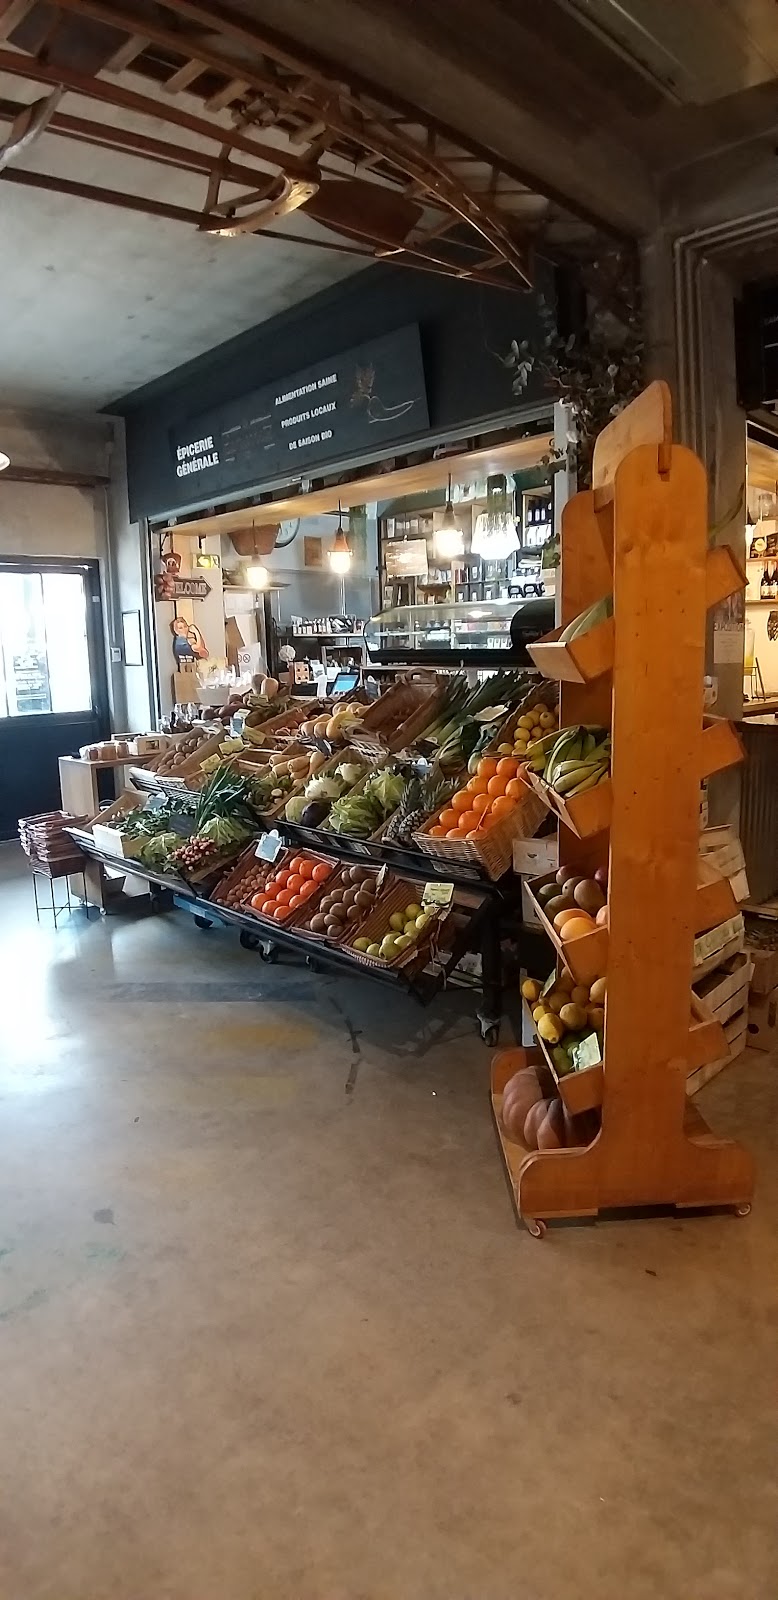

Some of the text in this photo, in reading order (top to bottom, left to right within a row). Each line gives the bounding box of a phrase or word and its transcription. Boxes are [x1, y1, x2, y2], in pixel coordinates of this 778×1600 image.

[275, 373, 338, 406] ALIMENTATION SAINE
[281, 401, 337, 429] PRODUITS LOCAUX
[176, 436, 214, 461] ÉPICERIE
[288, 429, 333, 451] DE SAISON BIO
[176, 452, 220, 478] GÉNÉRALE
